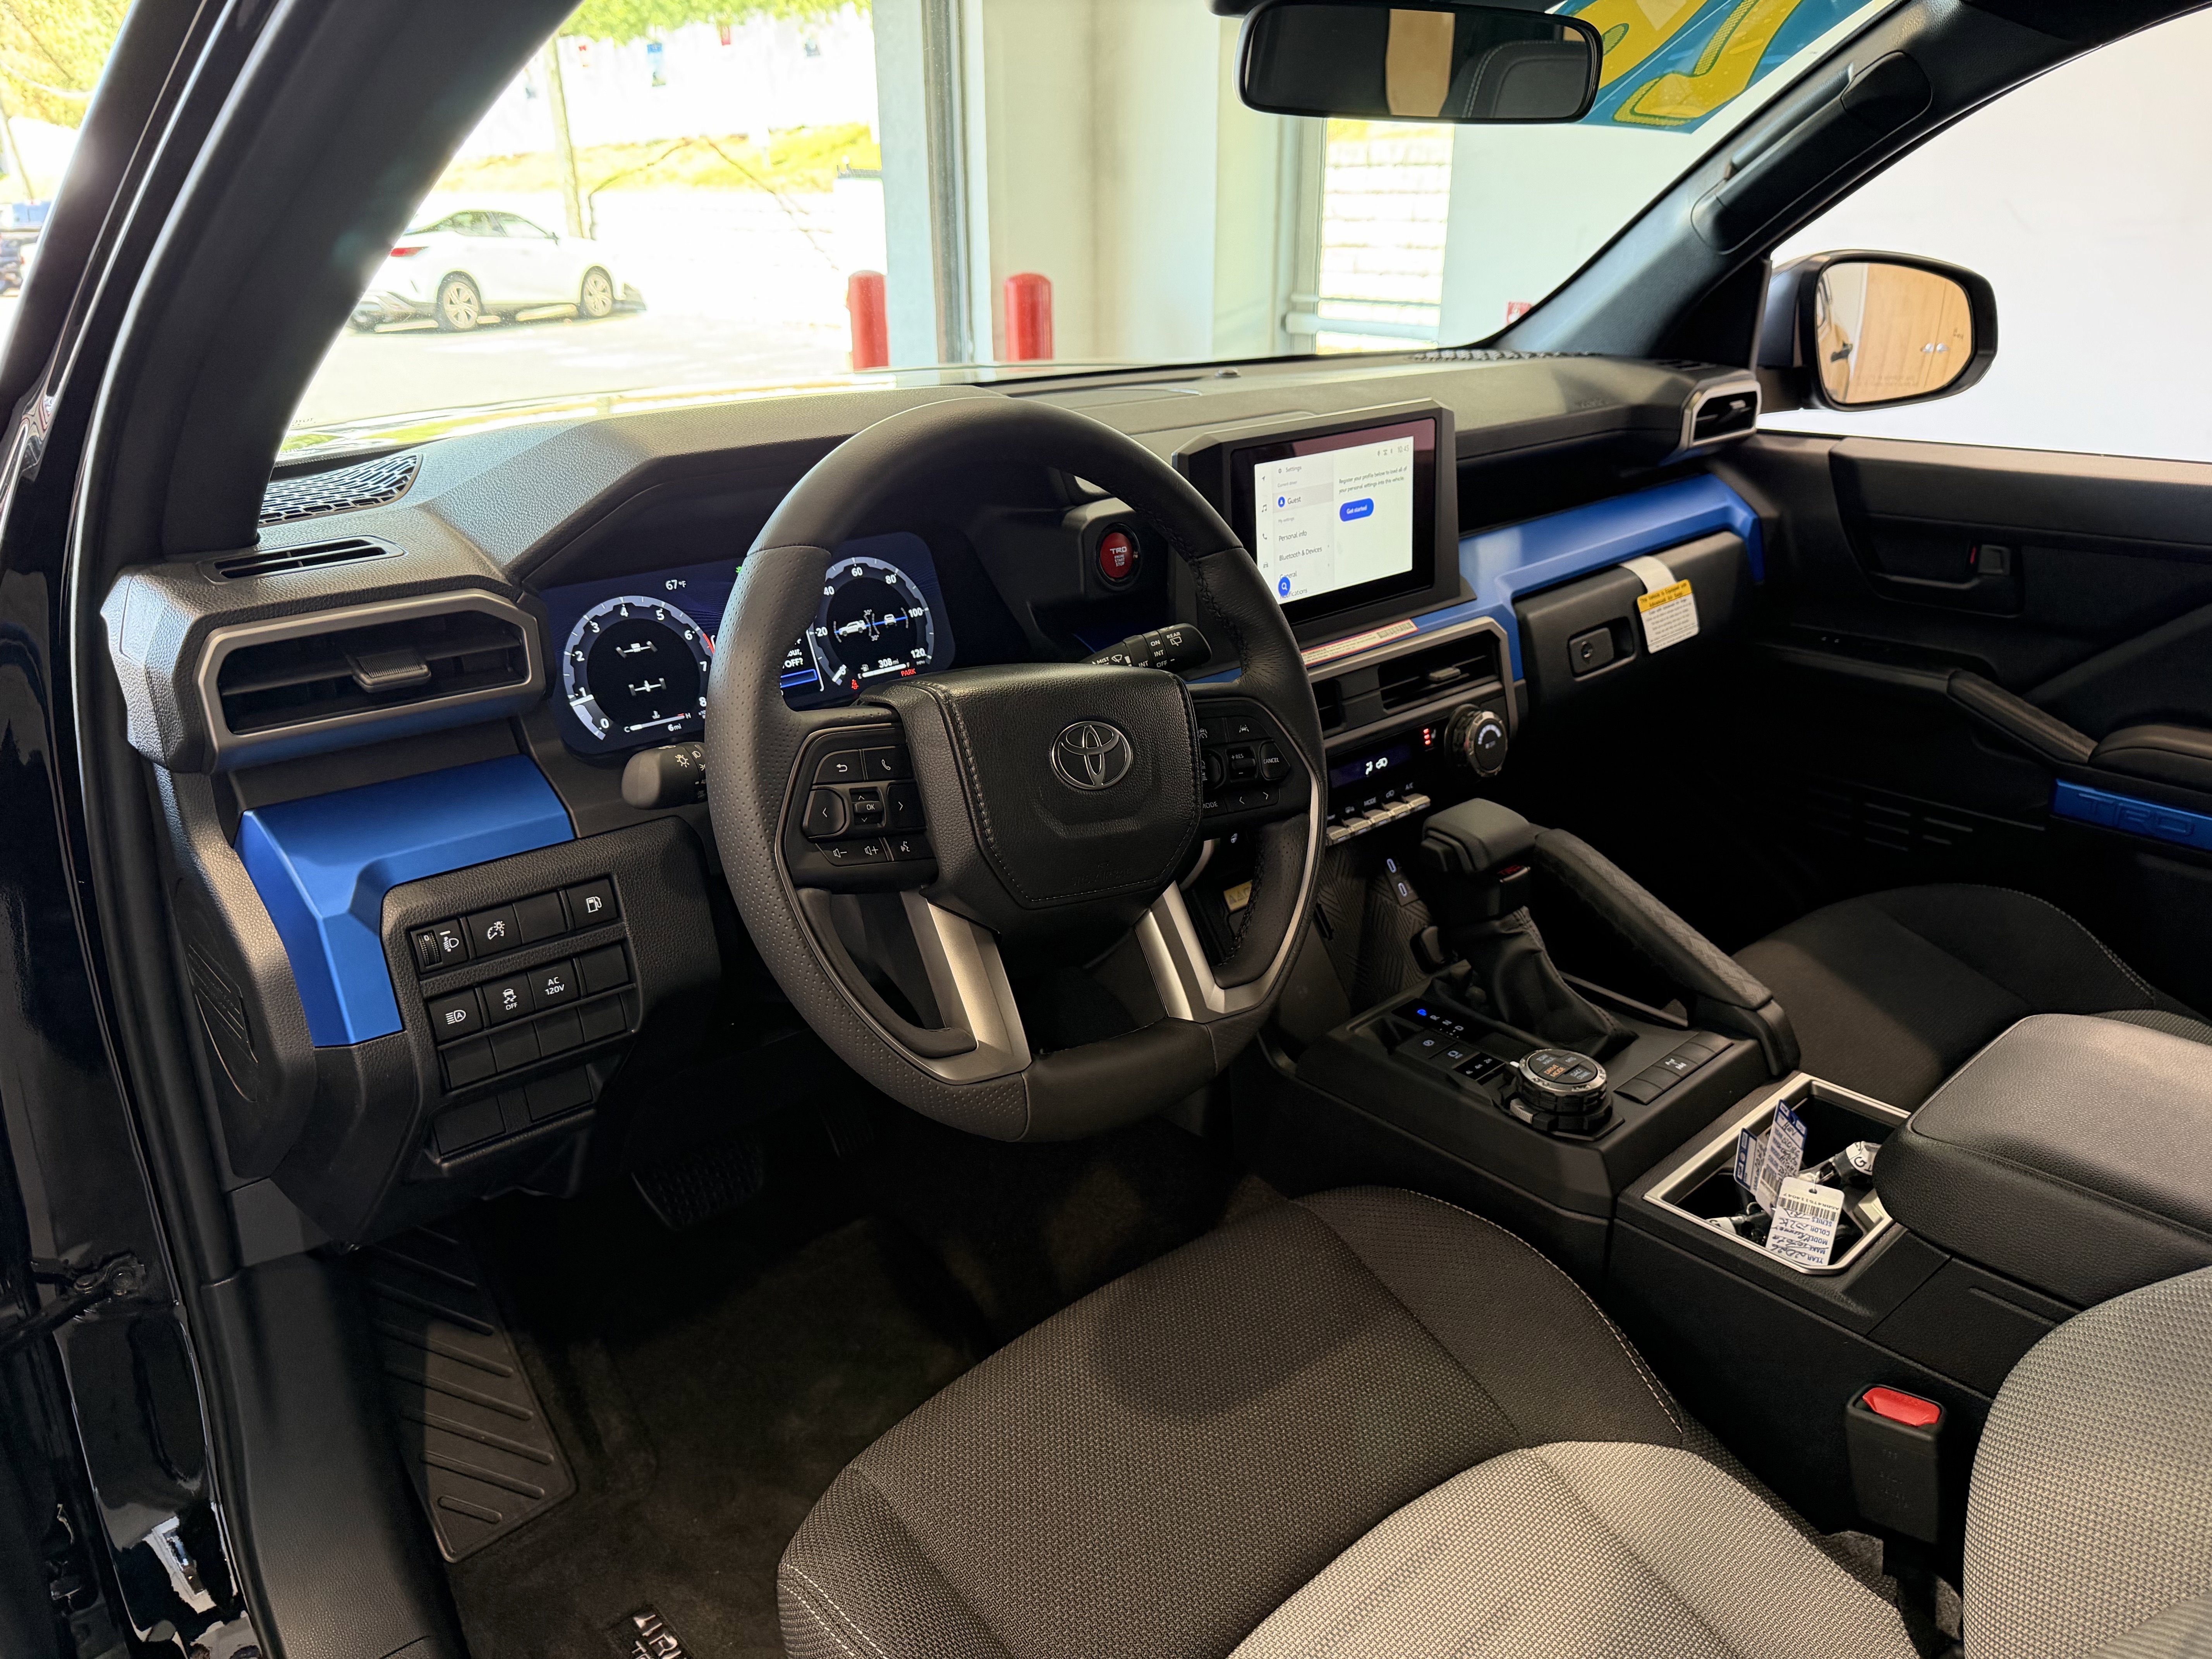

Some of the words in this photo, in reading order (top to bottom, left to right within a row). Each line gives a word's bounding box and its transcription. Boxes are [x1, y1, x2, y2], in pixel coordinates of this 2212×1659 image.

[1354, 505, 1367, 513] started
[1279, 532, 1297, 541] Personal
[1109, 546, 1127, 555] TRD
[1279, 551, 1300, 561] Bluetooth
[1306, 547, 1322, 555] Devices
[851, 567, 863, 577] 60
[1279, 570, 1297, 579] Gneral
[885, 574, 897, 584] 80
[823, 586, 835, 596] 40
[620, 607, 629, 617] 4
[656, 610, 665, 620] 5
[908, 606, 923, 618] 100
[592, 622, 600, 633] 3
[816, 626, 828, 637] 20
[684, 630, 693, 640] 6
[575, 651, 585, 661] 2
[787, 649, 802, 657] our,
[911, 648, 926, 659] 120
[700, 661, 707, 672] 7
[784, 657, 803, 668] OFF?
[901, 668, 917, 677] PARK
[579, 687, 587, 697] 1
[699, 697, 707, 707] 8
[600, 718, 609, 729] 0
[1364, 797, 1376, 807] MODE
[548, 977, 560, 986] AC
[545, 984, 565, 996] 120V
[505, 1002, 518, 1010] OFF
[1544, 1064, 1559, 1075] DRIVE
[1550, 1067, 1566, 1077] MODE
[1812, 1216, 1832, 1227] SERIES
[1810, 1227, 1830, 1236] COLOR
[1771, 1243, 1807, 1259] 2026
[1808, 1246, 1826, 1255] MAKE
[1807, 1254, 1823, 1264] YEAR
